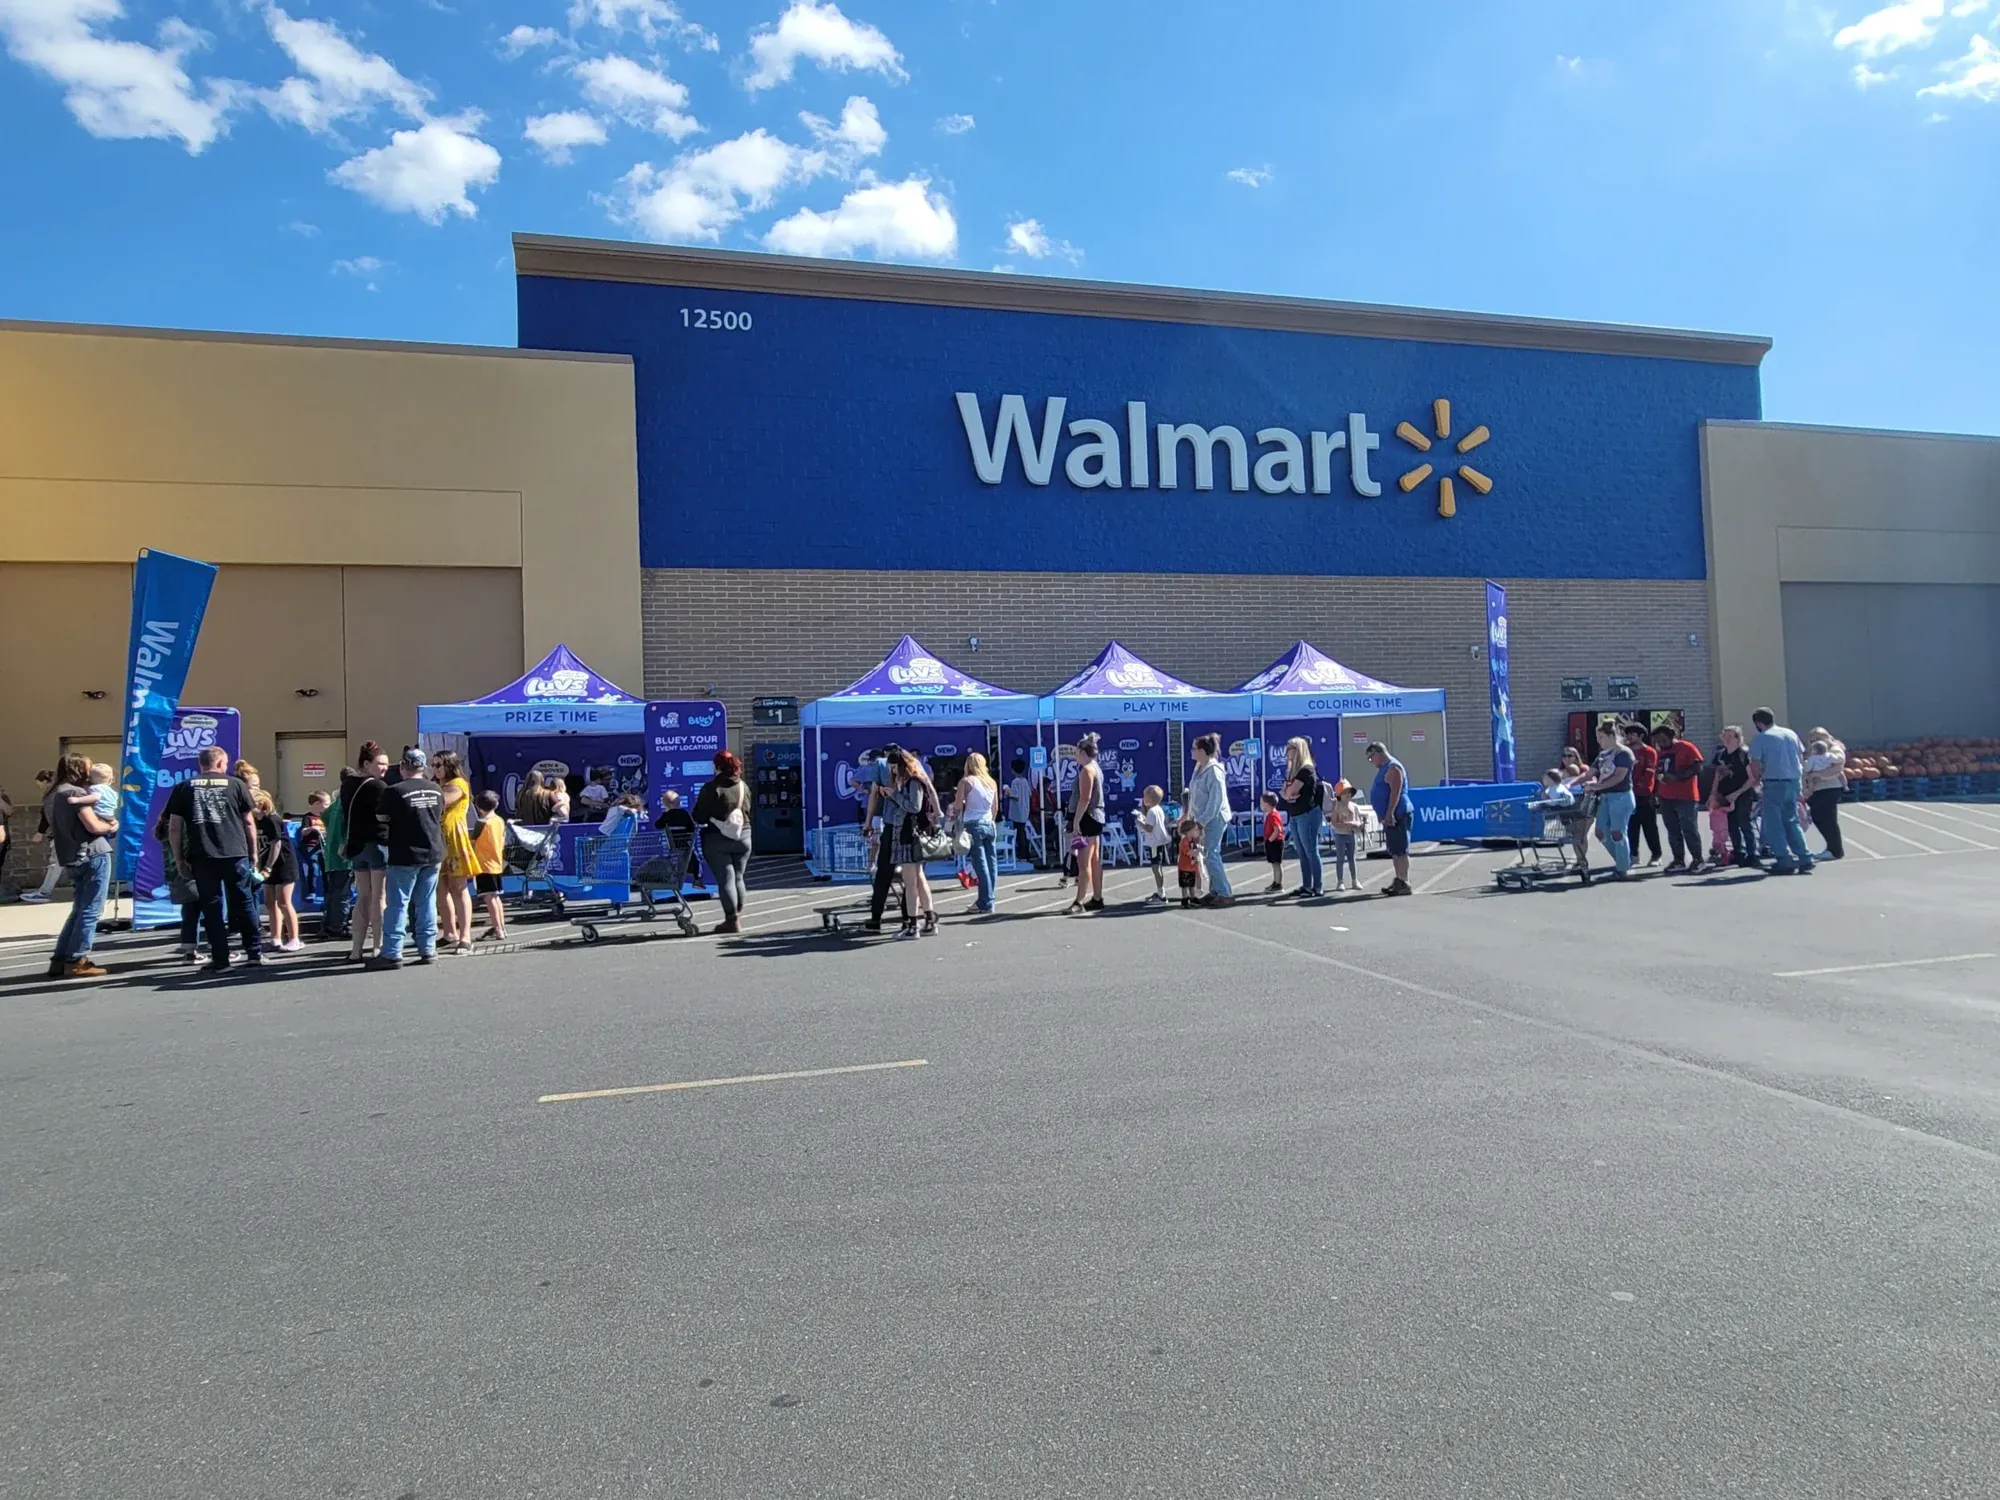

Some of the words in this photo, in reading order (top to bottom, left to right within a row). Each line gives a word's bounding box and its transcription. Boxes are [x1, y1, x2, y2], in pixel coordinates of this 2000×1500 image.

[680, 308, 752, 331] 12500
[955, 392, 1382, 497] Walmart
[891, 666, 942, 684] Luvs
[527, 678, 585, 696] Luvs
[888, 704, 935, 716] STORY
[939, 703, 973, 714] TIME
[1123, 702, 1156, 712] PLAY
[1160, 701, 1189, 712] TIME
[1308, 699, 1371, 710] COLORING
[1375, 697, 1403, 708] TIME
[505, 711, 553, 723] PRIZE
[559, 711, 598, 722] TIME
[768, 709, 783, 724] $1
[655, 736, 688, 745] BLUEY
[690, 735, 718, 744] TOUR
[777, 751, 801, 761] peps
[1098, 751, 1117, 763] uvs
[1270, 745, 1288, 760] Luv
[1420, 805, 1485, 822] Walmar
